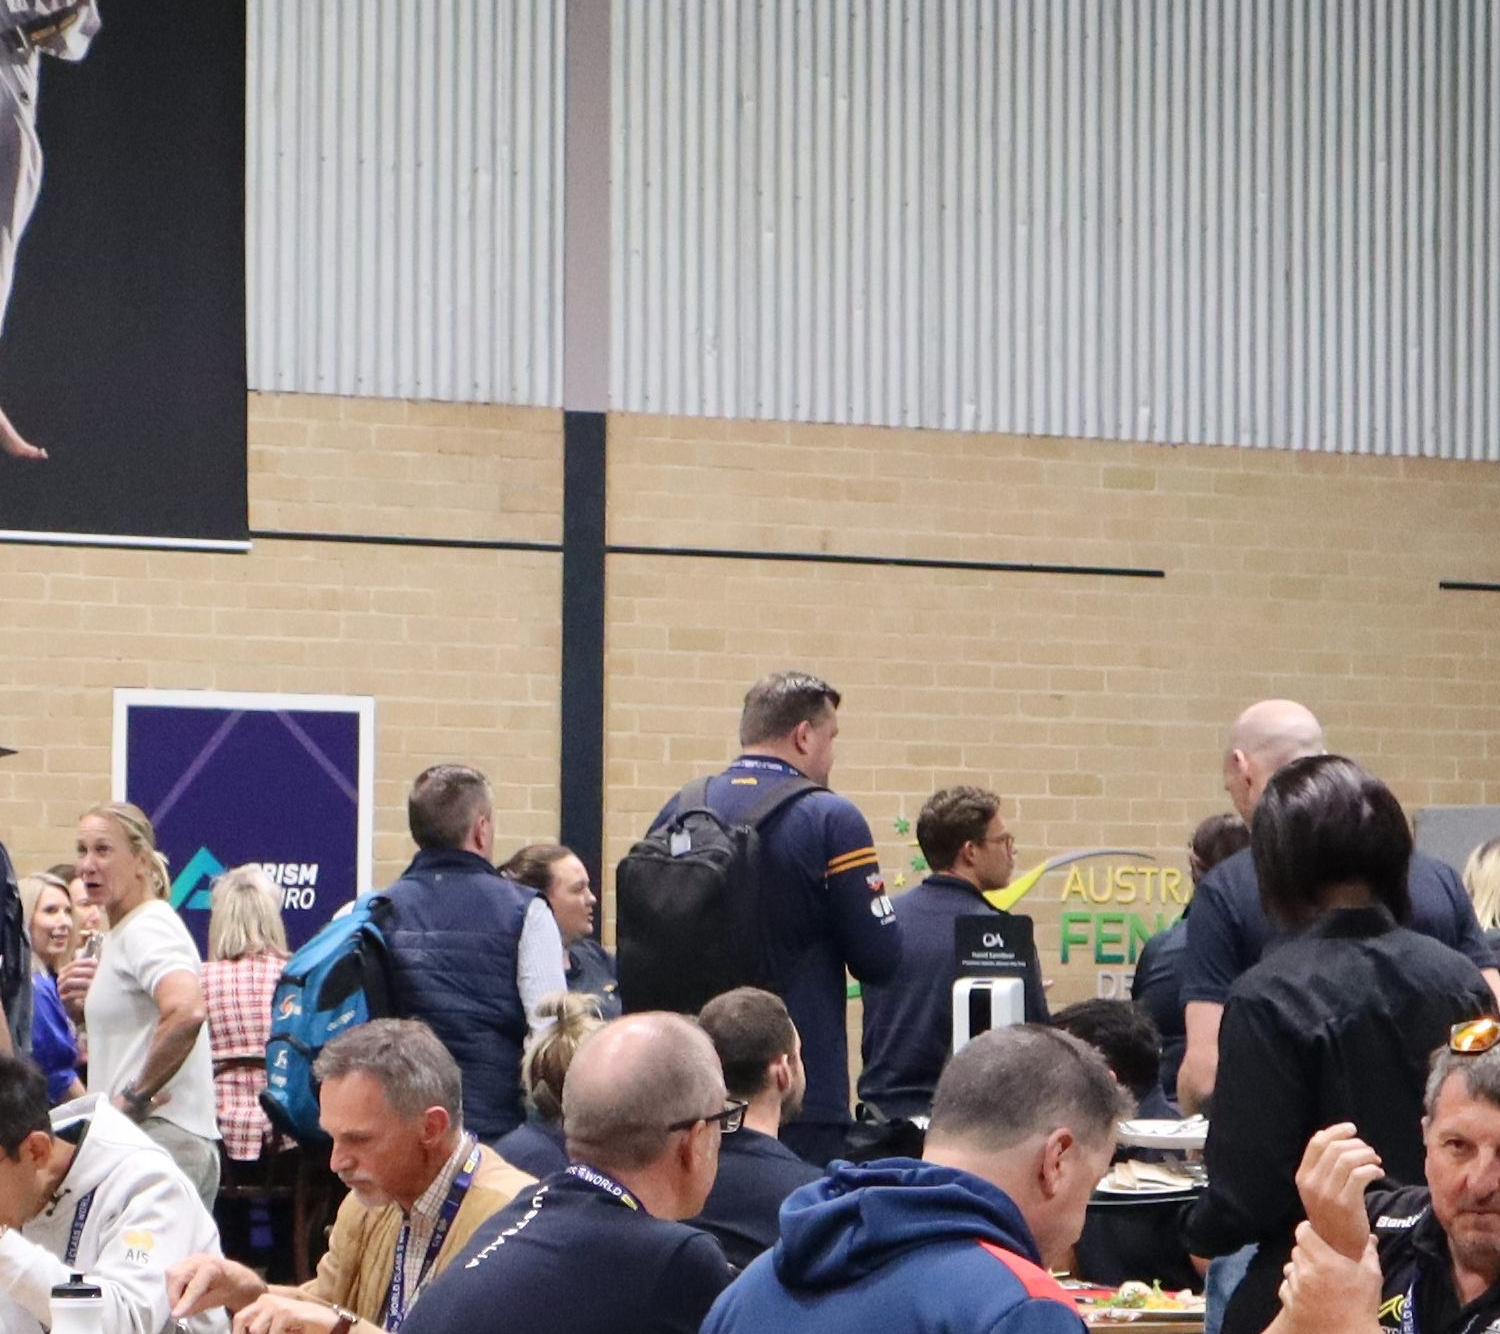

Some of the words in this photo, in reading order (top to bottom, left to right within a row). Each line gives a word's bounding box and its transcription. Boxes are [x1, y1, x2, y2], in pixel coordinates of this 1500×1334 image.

[262, 863, 319, 886] RISM
[584, 1172, 623, 1196] WORLD
[464, 1185, 549, 1269] AUSTRALIA
[124, 1248, 150, 1265] AIS
[390, 1284, 401, 1317] WORLD
